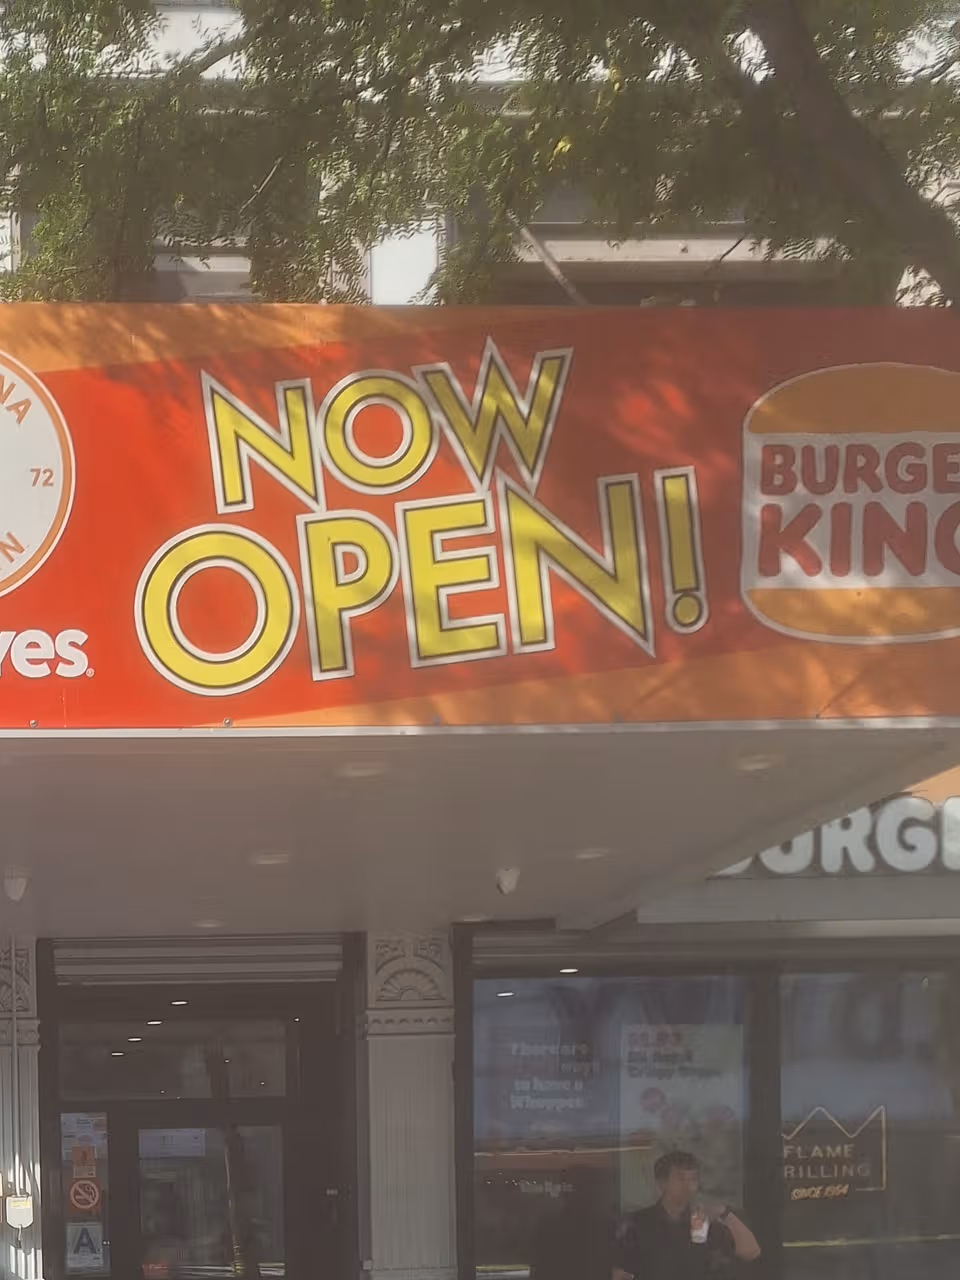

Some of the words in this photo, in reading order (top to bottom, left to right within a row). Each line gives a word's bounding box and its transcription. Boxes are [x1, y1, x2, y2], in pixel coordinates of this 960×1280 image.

[201, 336, 574, 514] NOW
[29, 467, 55, 488] 72
[135, 467, 709, 697] OPEN!
[783, 1144, 855, 1158] FLAME
[783, 1162, 871, 1178] RILLING
[73, 1227, 97, 1255] A
